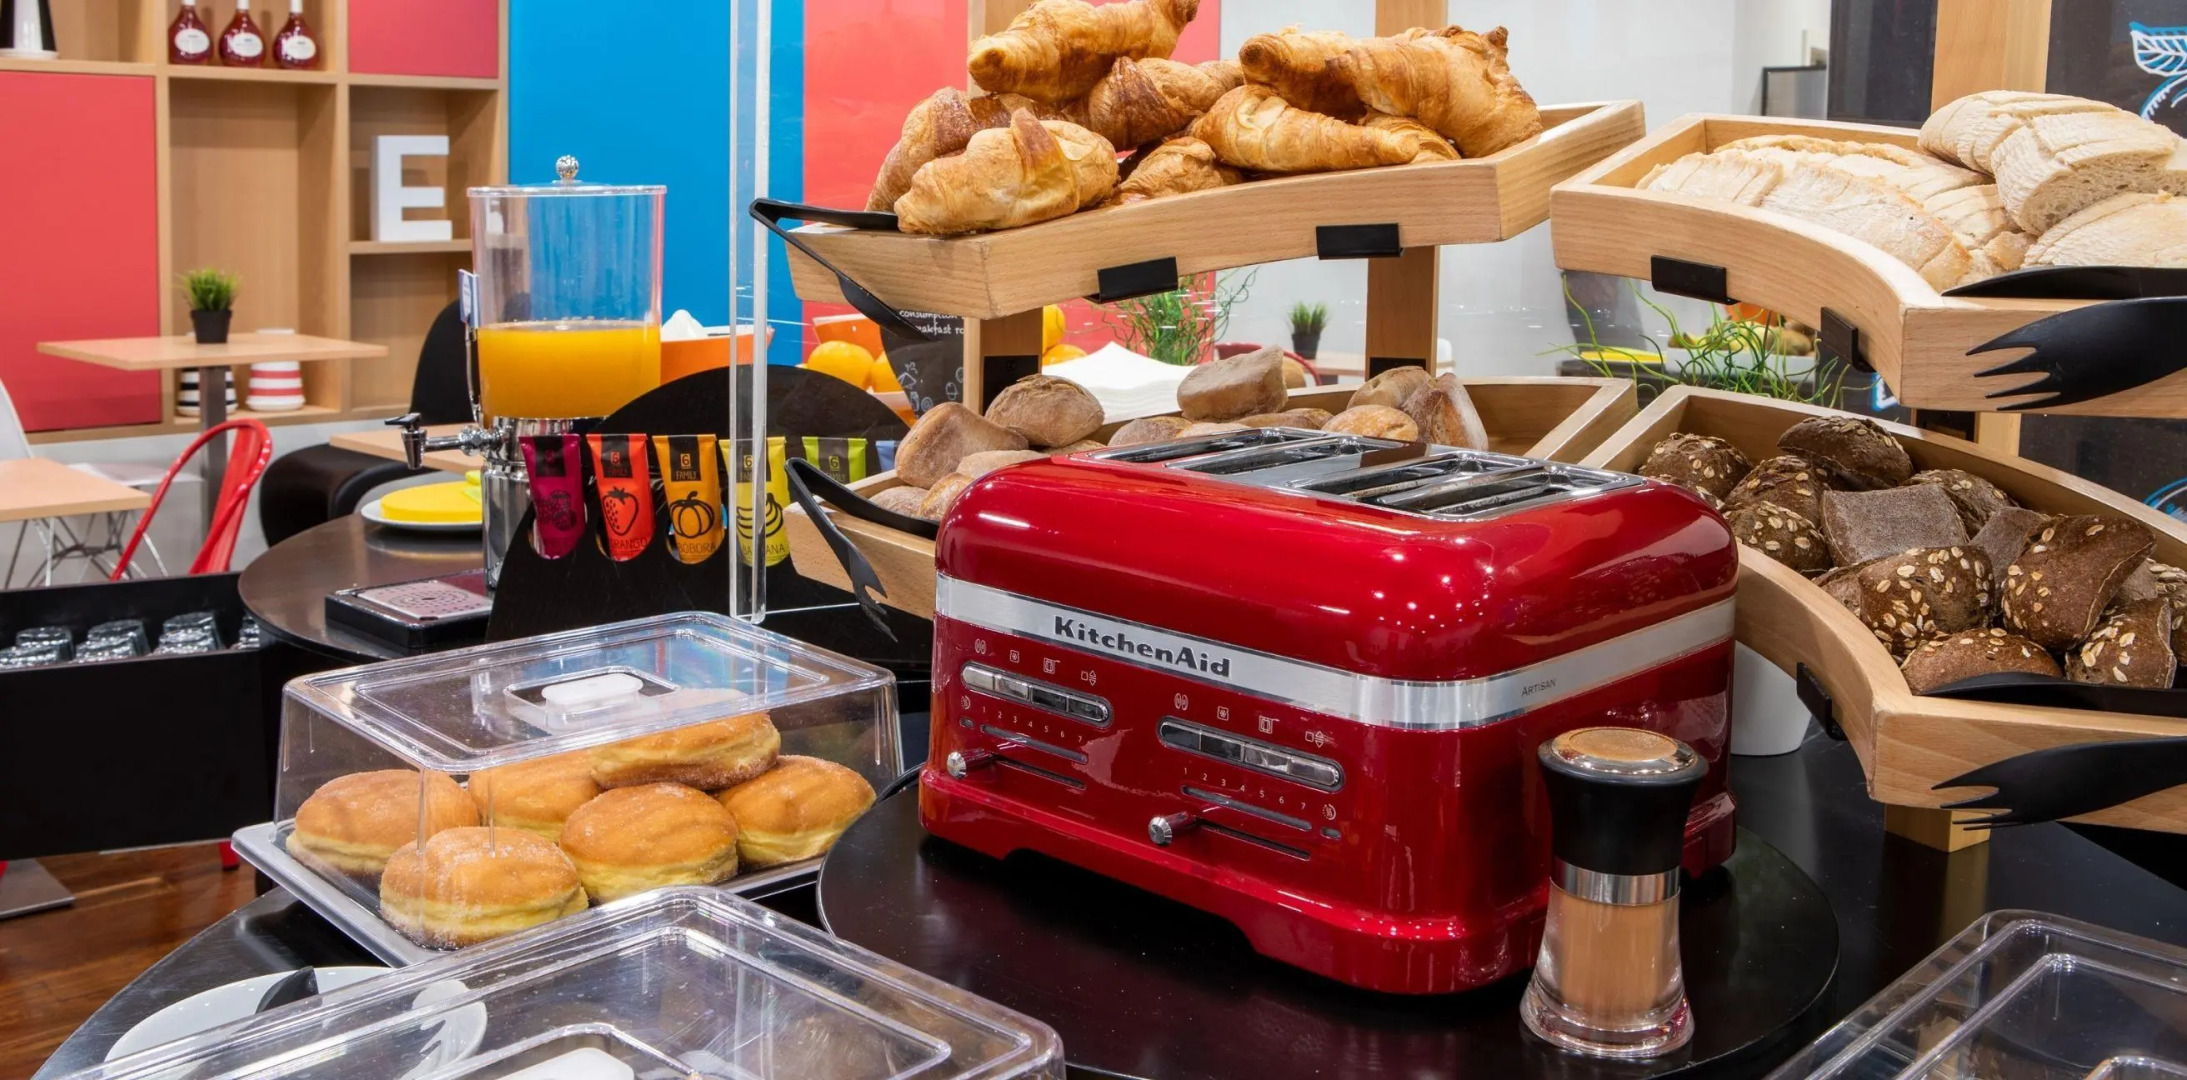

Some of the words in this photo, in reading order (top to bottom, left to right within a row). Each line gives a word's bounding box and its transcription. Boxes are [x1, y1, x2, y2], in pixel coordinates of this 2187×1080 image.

[371, 134, 452, 242] E
[675, 471, 698, 480] FAMILY
[610, 538, 648, 550] RANGO
[741, 543, 786, 556] BAANA
[1054, 615, 1231, 678] KitchenAid
